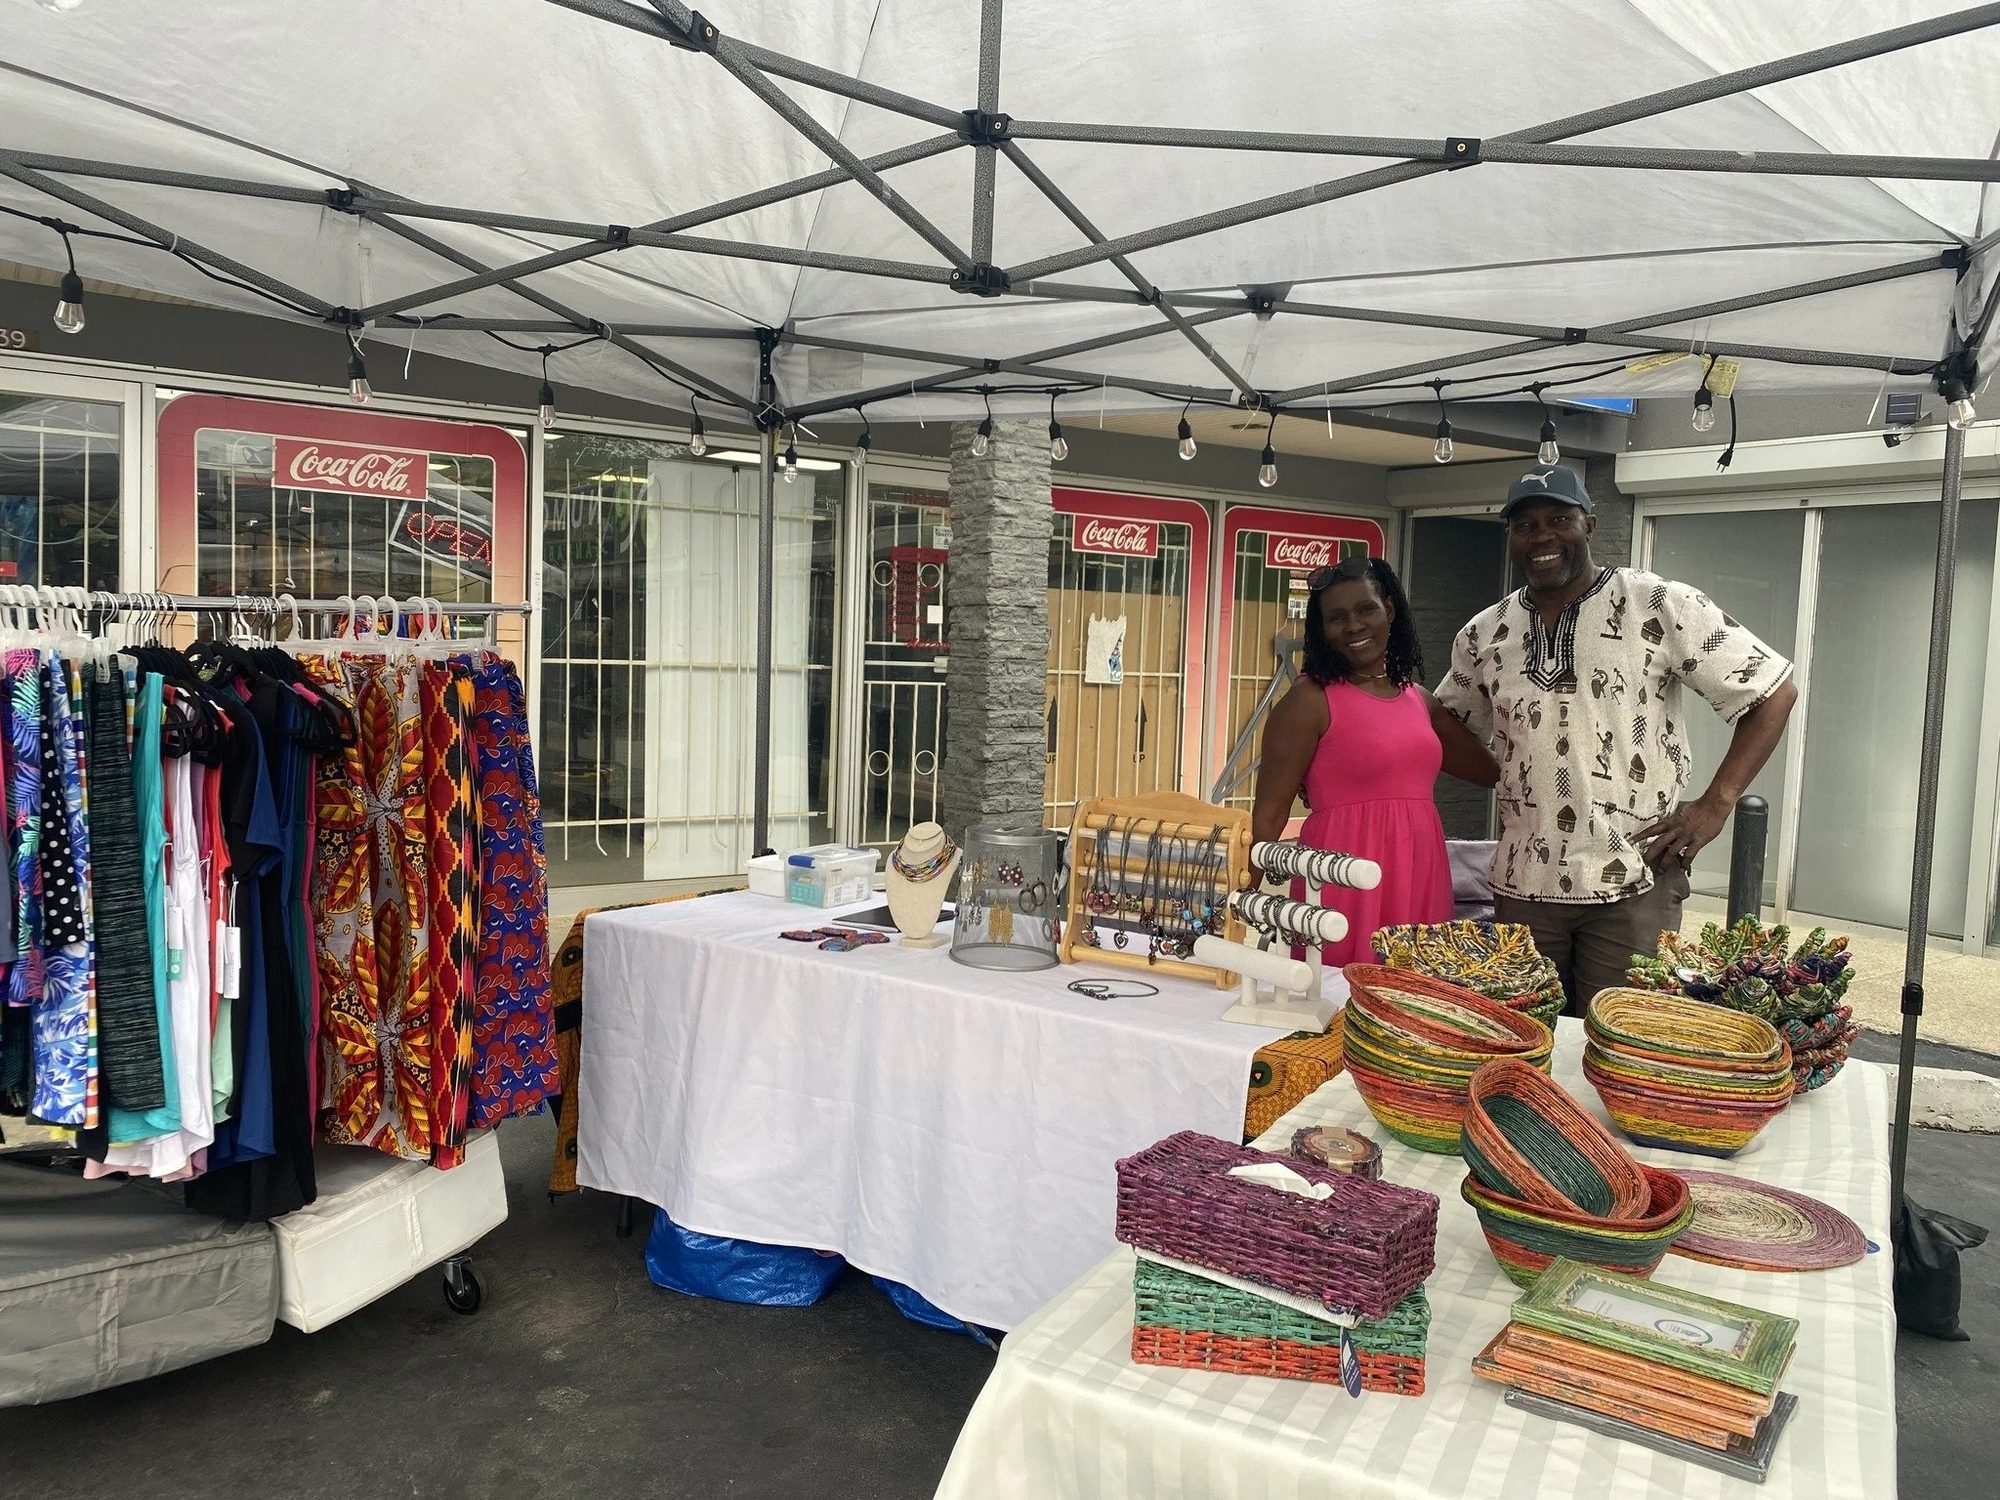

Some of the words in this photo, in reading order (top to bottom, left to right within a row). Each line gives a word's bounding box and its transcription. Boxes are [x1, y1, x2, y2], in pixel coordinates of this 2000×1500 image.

[289, 446, 414, 492] Coca-Cola
[1081, 519, 1151, 551] Coca-Cola
[1274, 538, 1333, 566] Coca-Cola
